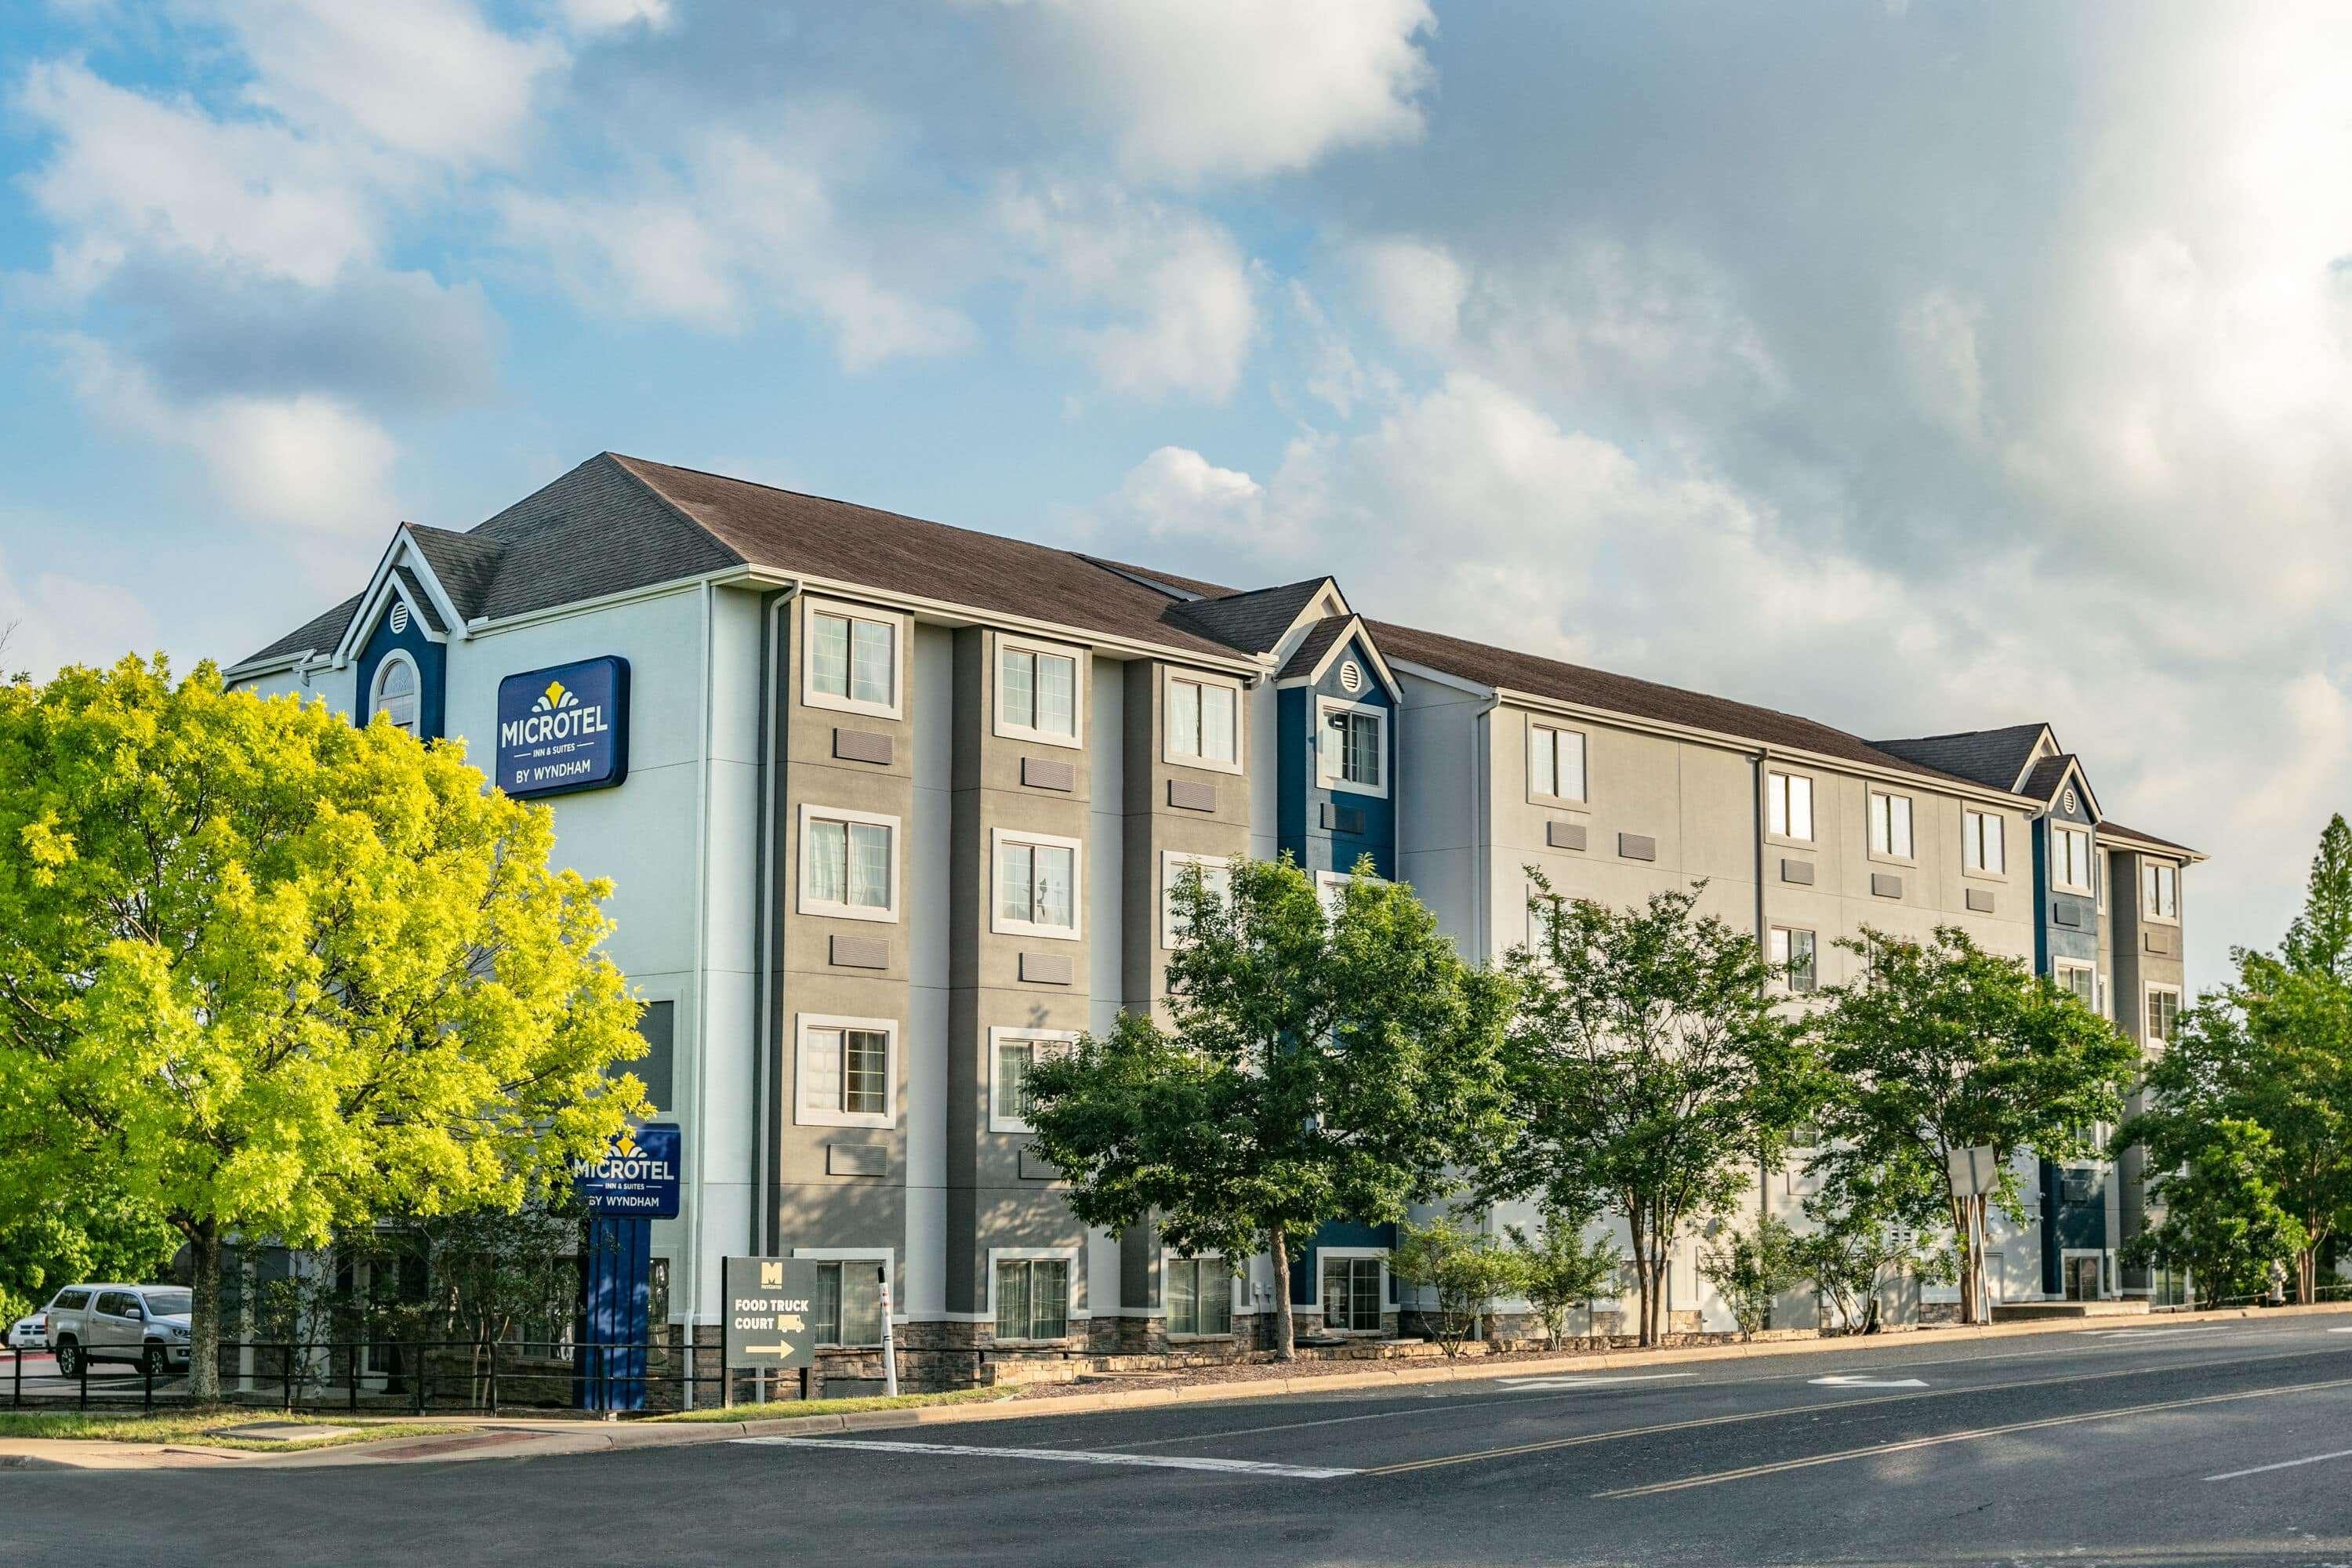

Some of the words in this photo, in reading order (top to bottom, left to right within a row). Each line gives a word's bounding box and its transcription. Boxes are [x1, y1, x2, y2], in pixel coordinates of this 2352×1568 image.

[501, 705, 608, 748] MICROTEL
[533, 747, 545, 757] INN
[546, 747, 551, 756] &
[553, 743, 575, 754] SUITES
[516, 769, 530, 784] BY
[534, 759, 591, 780] WYNDHAM
[574, 1159, 674, 1180] MICROTEL
[606, 1196, 659, 1207] WYNDHAM
[761, 1261, 782, 1284] M
[735, 1299, 767, 1312] FOOD
[770, 1299, 809, 1312] TRUCK
[735, 1318, 774, 1330] COURT
